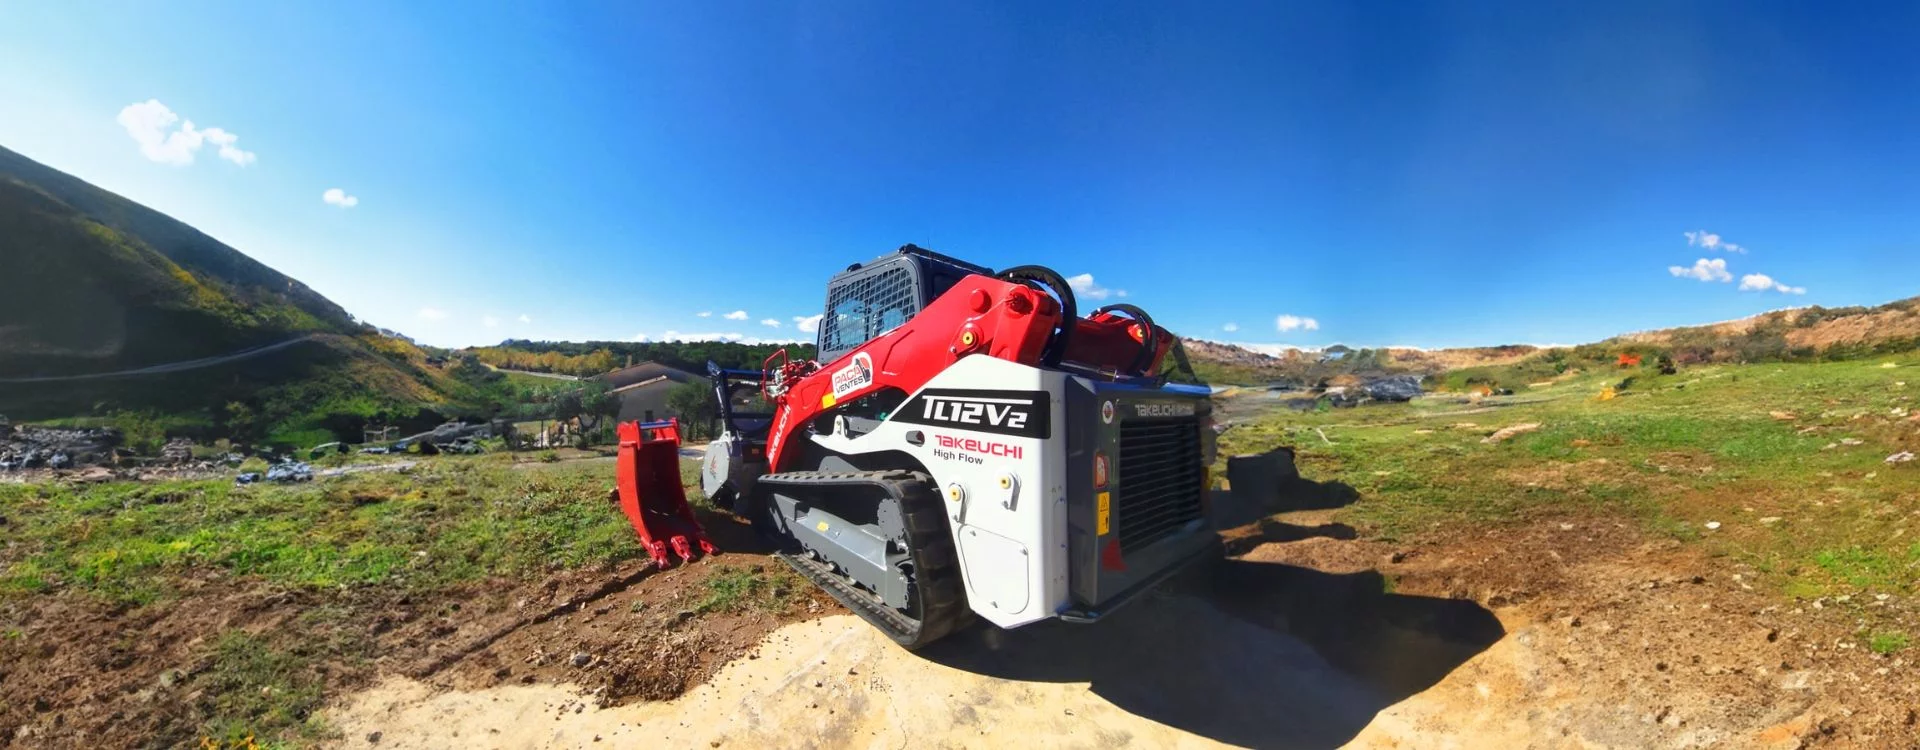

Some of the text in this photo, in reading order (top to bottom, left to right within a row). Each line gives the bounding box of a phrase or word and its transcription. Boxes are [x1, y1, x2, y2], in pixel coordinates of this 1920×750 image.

[835, 366, 862, 386] PACA
[836, 376, 864, 393] VENTES
[933, 449, 984, 465] High Flow
